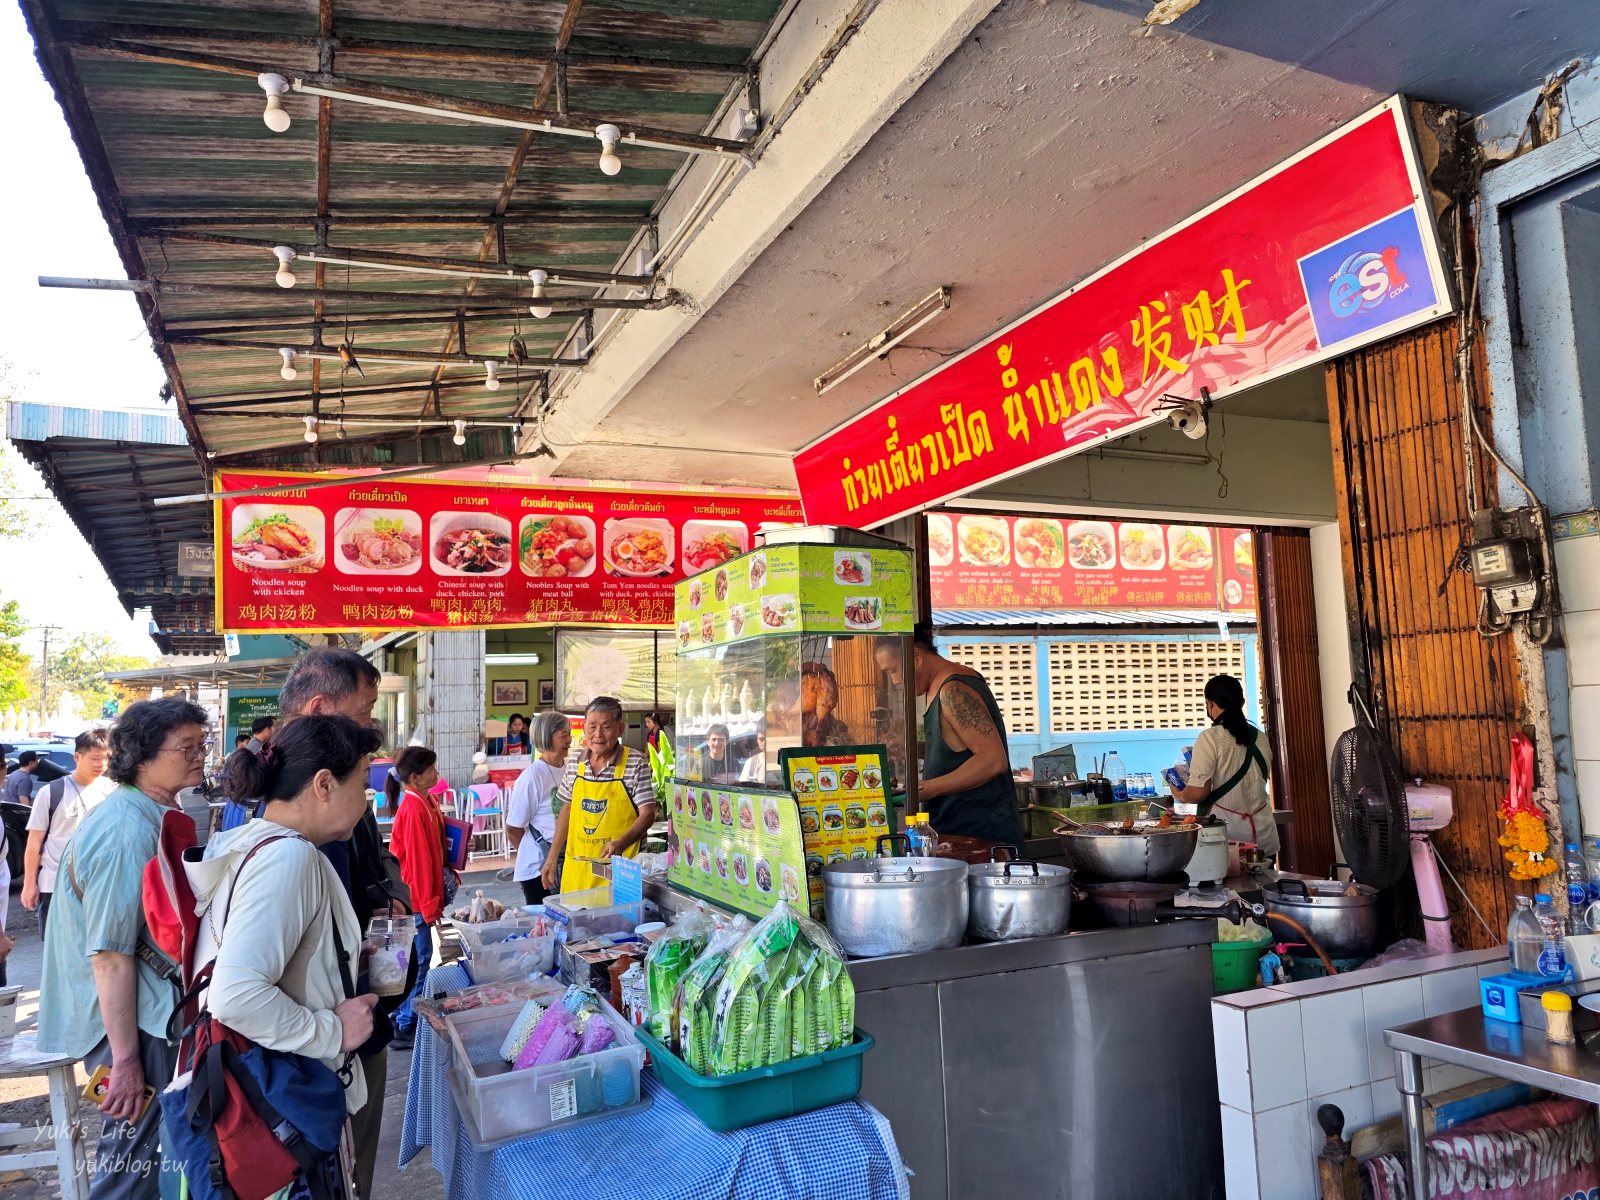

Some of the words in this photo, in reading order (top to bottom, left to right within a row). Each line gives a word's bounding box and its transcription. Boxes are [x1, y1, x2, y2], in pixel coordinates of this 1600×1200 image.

[1329, 245, 1407, 318] est
[1389, 282, 1410, 299] COLA
[996, 341, 1125, 445] น้ำแดง
[1130, 268, 1252, 386] 发财
[453, 496, 489, 506] เกาเหลา
[251, 578, 285, 587] Noodles
[287, 579, 307, 588] soup
[438, 581, 466, 589] Chinese
[469, 582, 486, 590] soup
[488, 581, 504, 589] with
[556, 582, 573, 590] Soup
[253, 588, 271, 596] with
[333, 584, 364, 592] Noodles
[366, 585, 384, 593] soup
[387, 585, 403, 593] with
[405, 585, 424, 593] duck
[489, 590, 505, 598] pork
[238, 603, 317, 621] 鸡肉汤粉
[342, 603, 414, 620] 鸭肉汤粉
[447, 610, 494, 624] 猪肉汤
